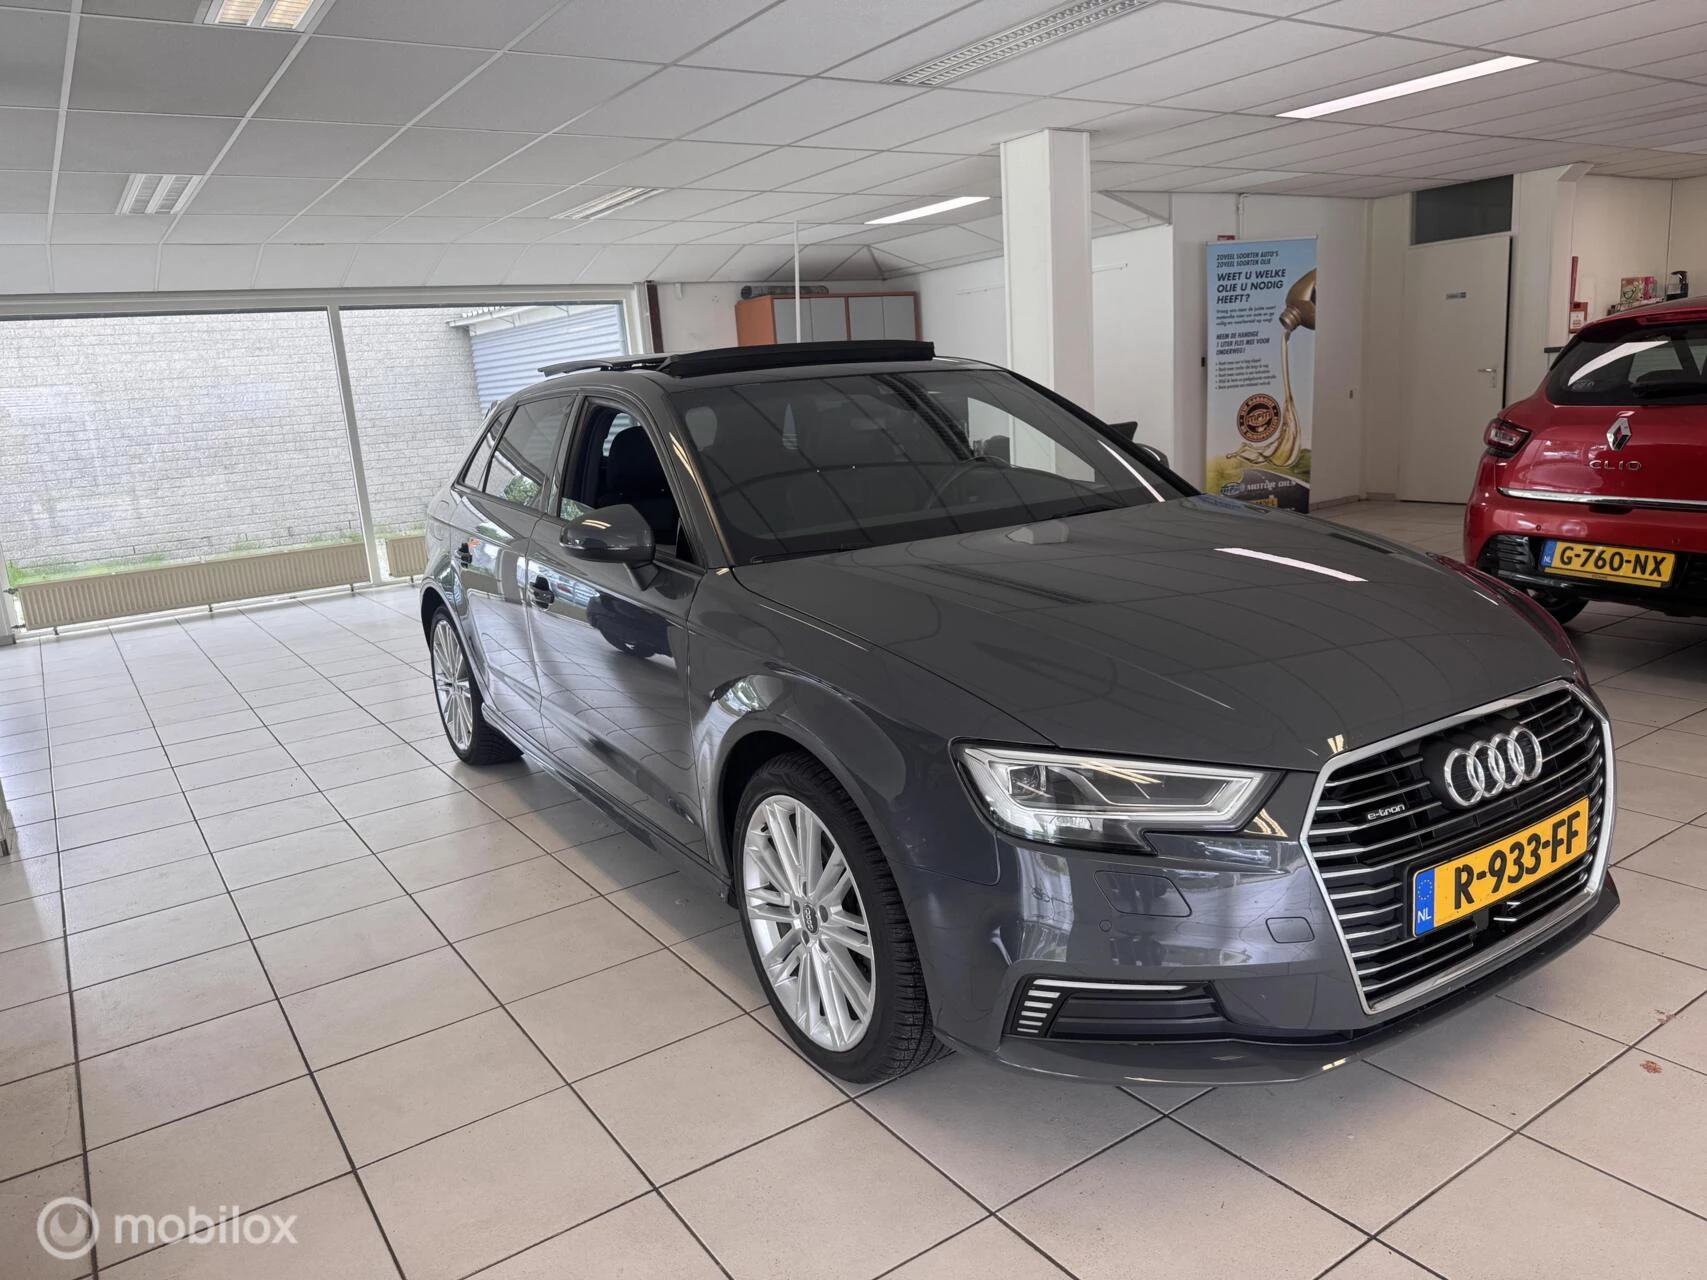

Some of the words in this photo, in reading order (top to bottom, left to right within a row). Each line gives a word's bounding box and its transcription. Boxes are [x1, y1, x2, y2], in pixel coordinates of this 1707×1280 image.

[1236, 252, 1259, 260] SOORTEN
[1236, 259, 1259, 267] SOORTEN
[1217, 272, 1242, 282] WEET
[1245, 271, 1252, 280] U
[1255, 268, 1287, 279] WELKE
[1216, 283, 1238, 293] OLIE
[1241, 282, 1247, 292] U
[1250, 280, 1284, 291] NODIG
[1216, 294, 1250, 305] HEEFT?
[1589, 460, 1642, 471] CLIO
[1559, 546, 1666, 578] G-760-NX
[1367, 804, 1406, 820] e-tron
[1454, 810, 1581, 910] R-933-FF
[1417, 907, 1432, 923] NL
